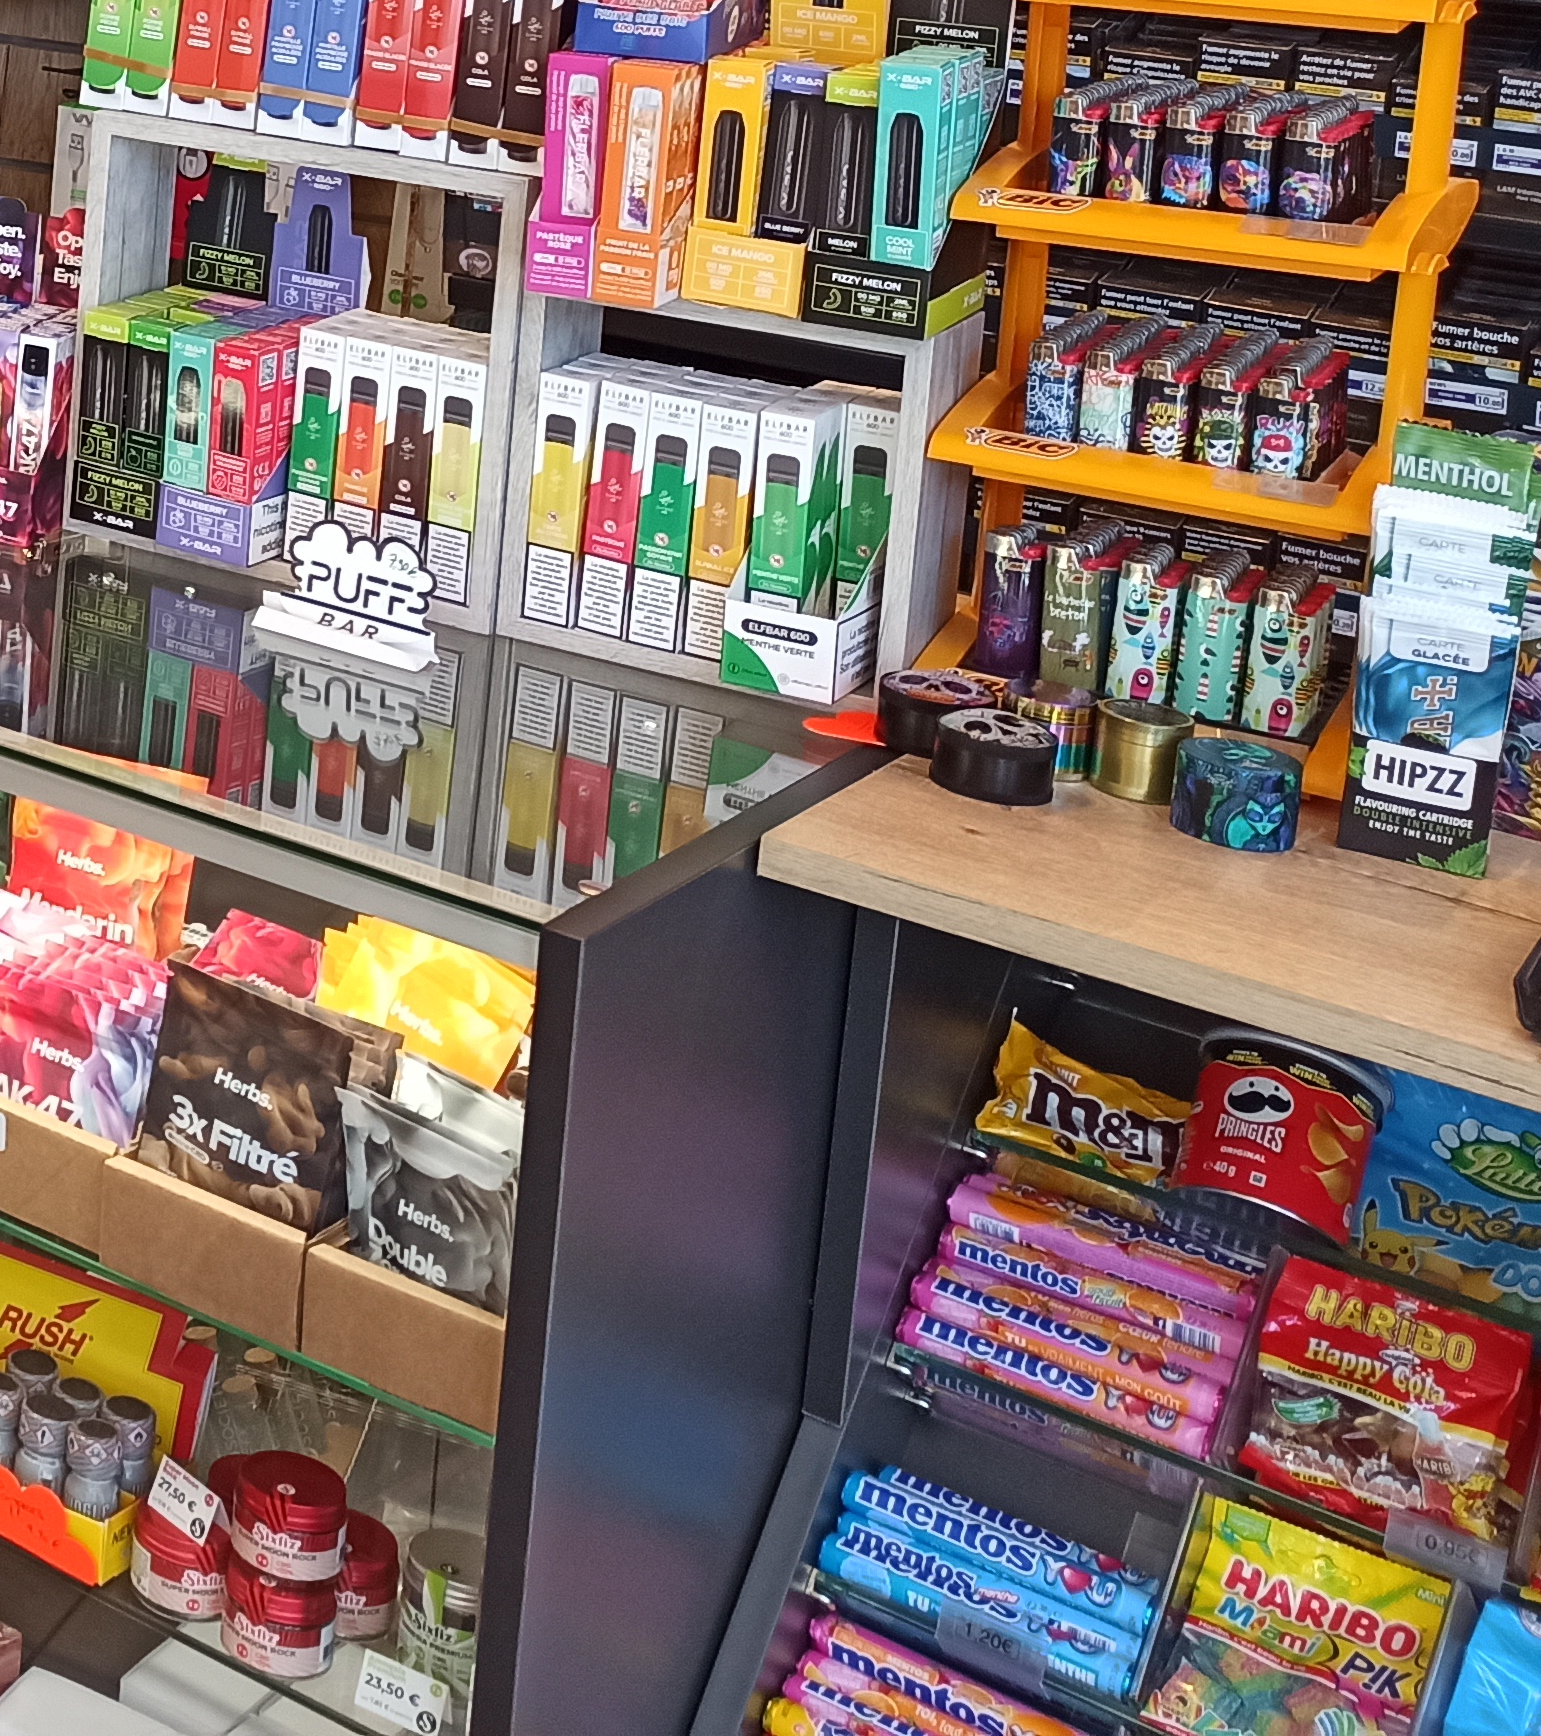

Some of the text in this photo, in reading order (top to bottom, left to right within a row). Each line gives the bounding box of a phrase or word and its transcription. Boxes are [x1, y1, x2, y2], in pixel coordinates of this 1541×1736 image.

[1393, 453, 1513, 497] MENTHOL
[304, 562, 426, 615] PUFF
[318, 611, 380, 639] BAR
[1373, 754, 1468, 799] HIPZZ
[1355, 796, 1474, 830] FLAVOURING CARTRIDGE
[214, 1067, 273, 1112] Herbs.
[168, 1095, 298, 1185] 3x Filtré
[1217, 1115, 1286, 1154] PRINGLES
[958, 1238, 1080, 1298] mentos
[1305, 1285, 1476, 1372] HARIBO
[1227, 1558, 1419, 1658] HARIBO
